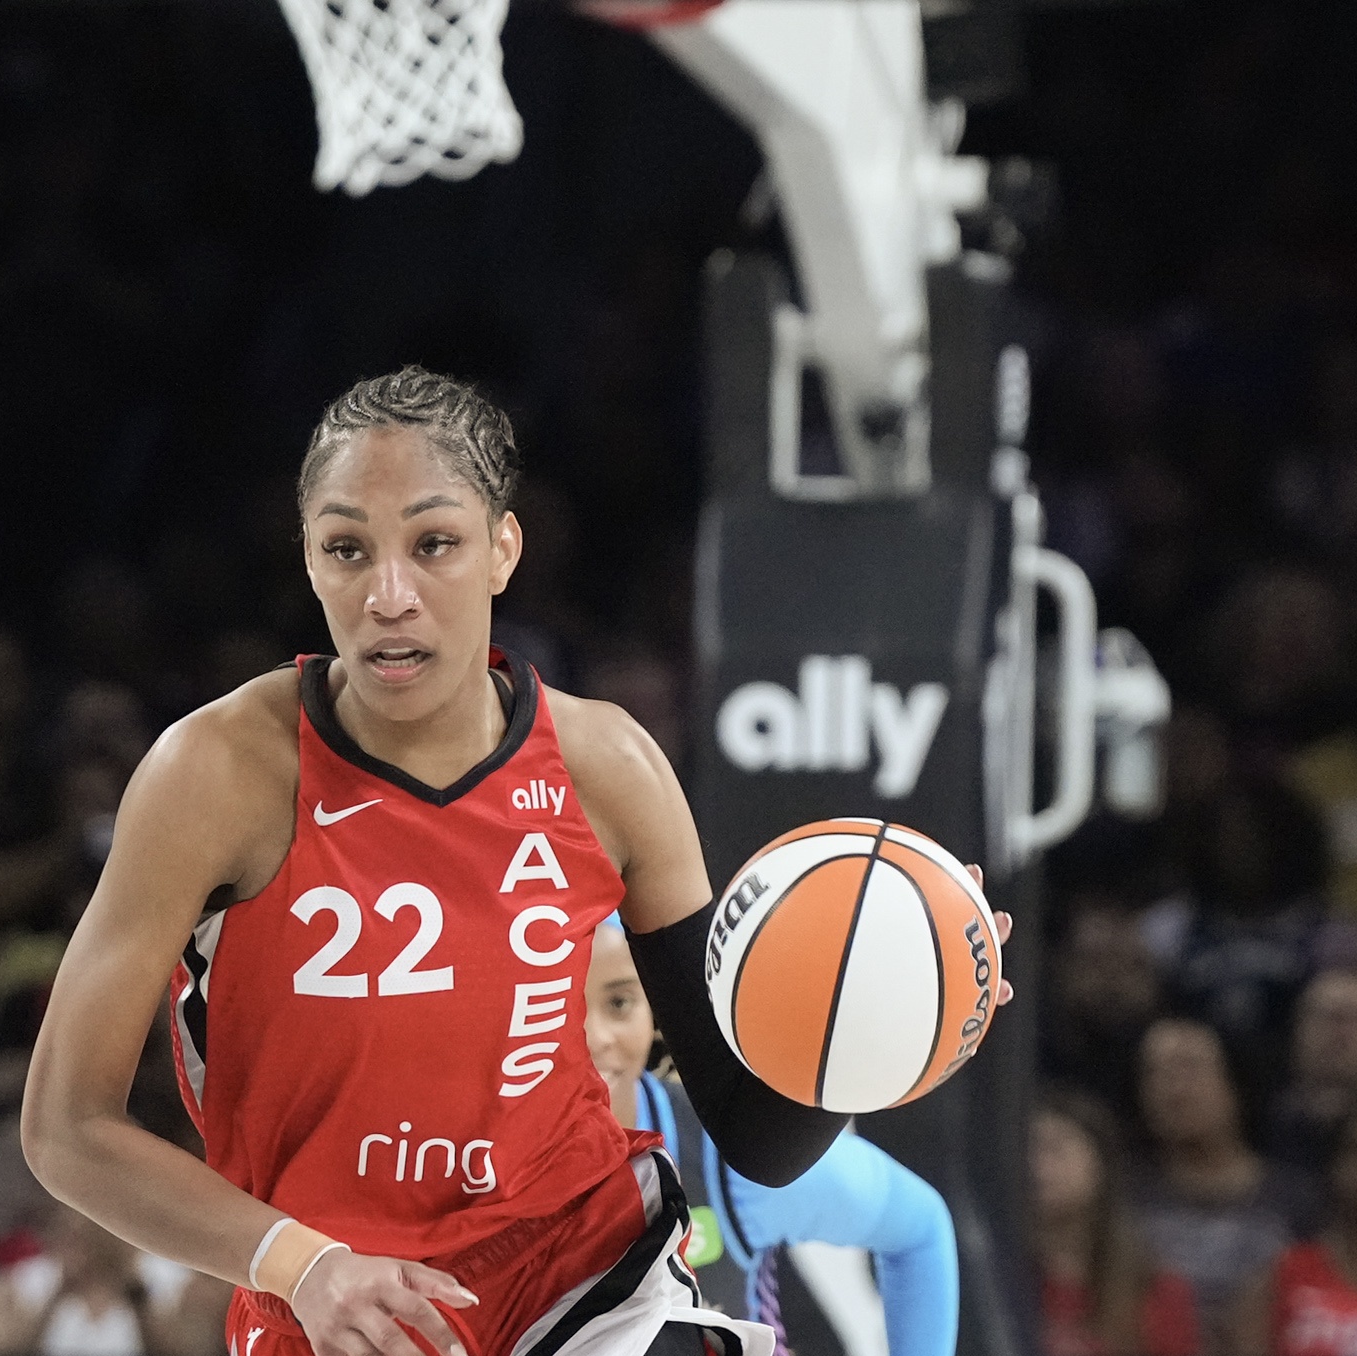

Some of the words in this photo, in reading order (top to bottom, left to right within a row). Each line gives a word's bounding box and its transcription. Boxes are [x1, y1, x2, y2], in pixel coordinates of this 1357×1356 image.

[717, 654, 950, 798] ally
[511, 779, 567, 816] ally
[290, 882, 455, 999] 22
[498, 832, 576, 1098] ACES
[928, 915, 991, 1092] ilson
[357, 1121, 497, 1194] ring
